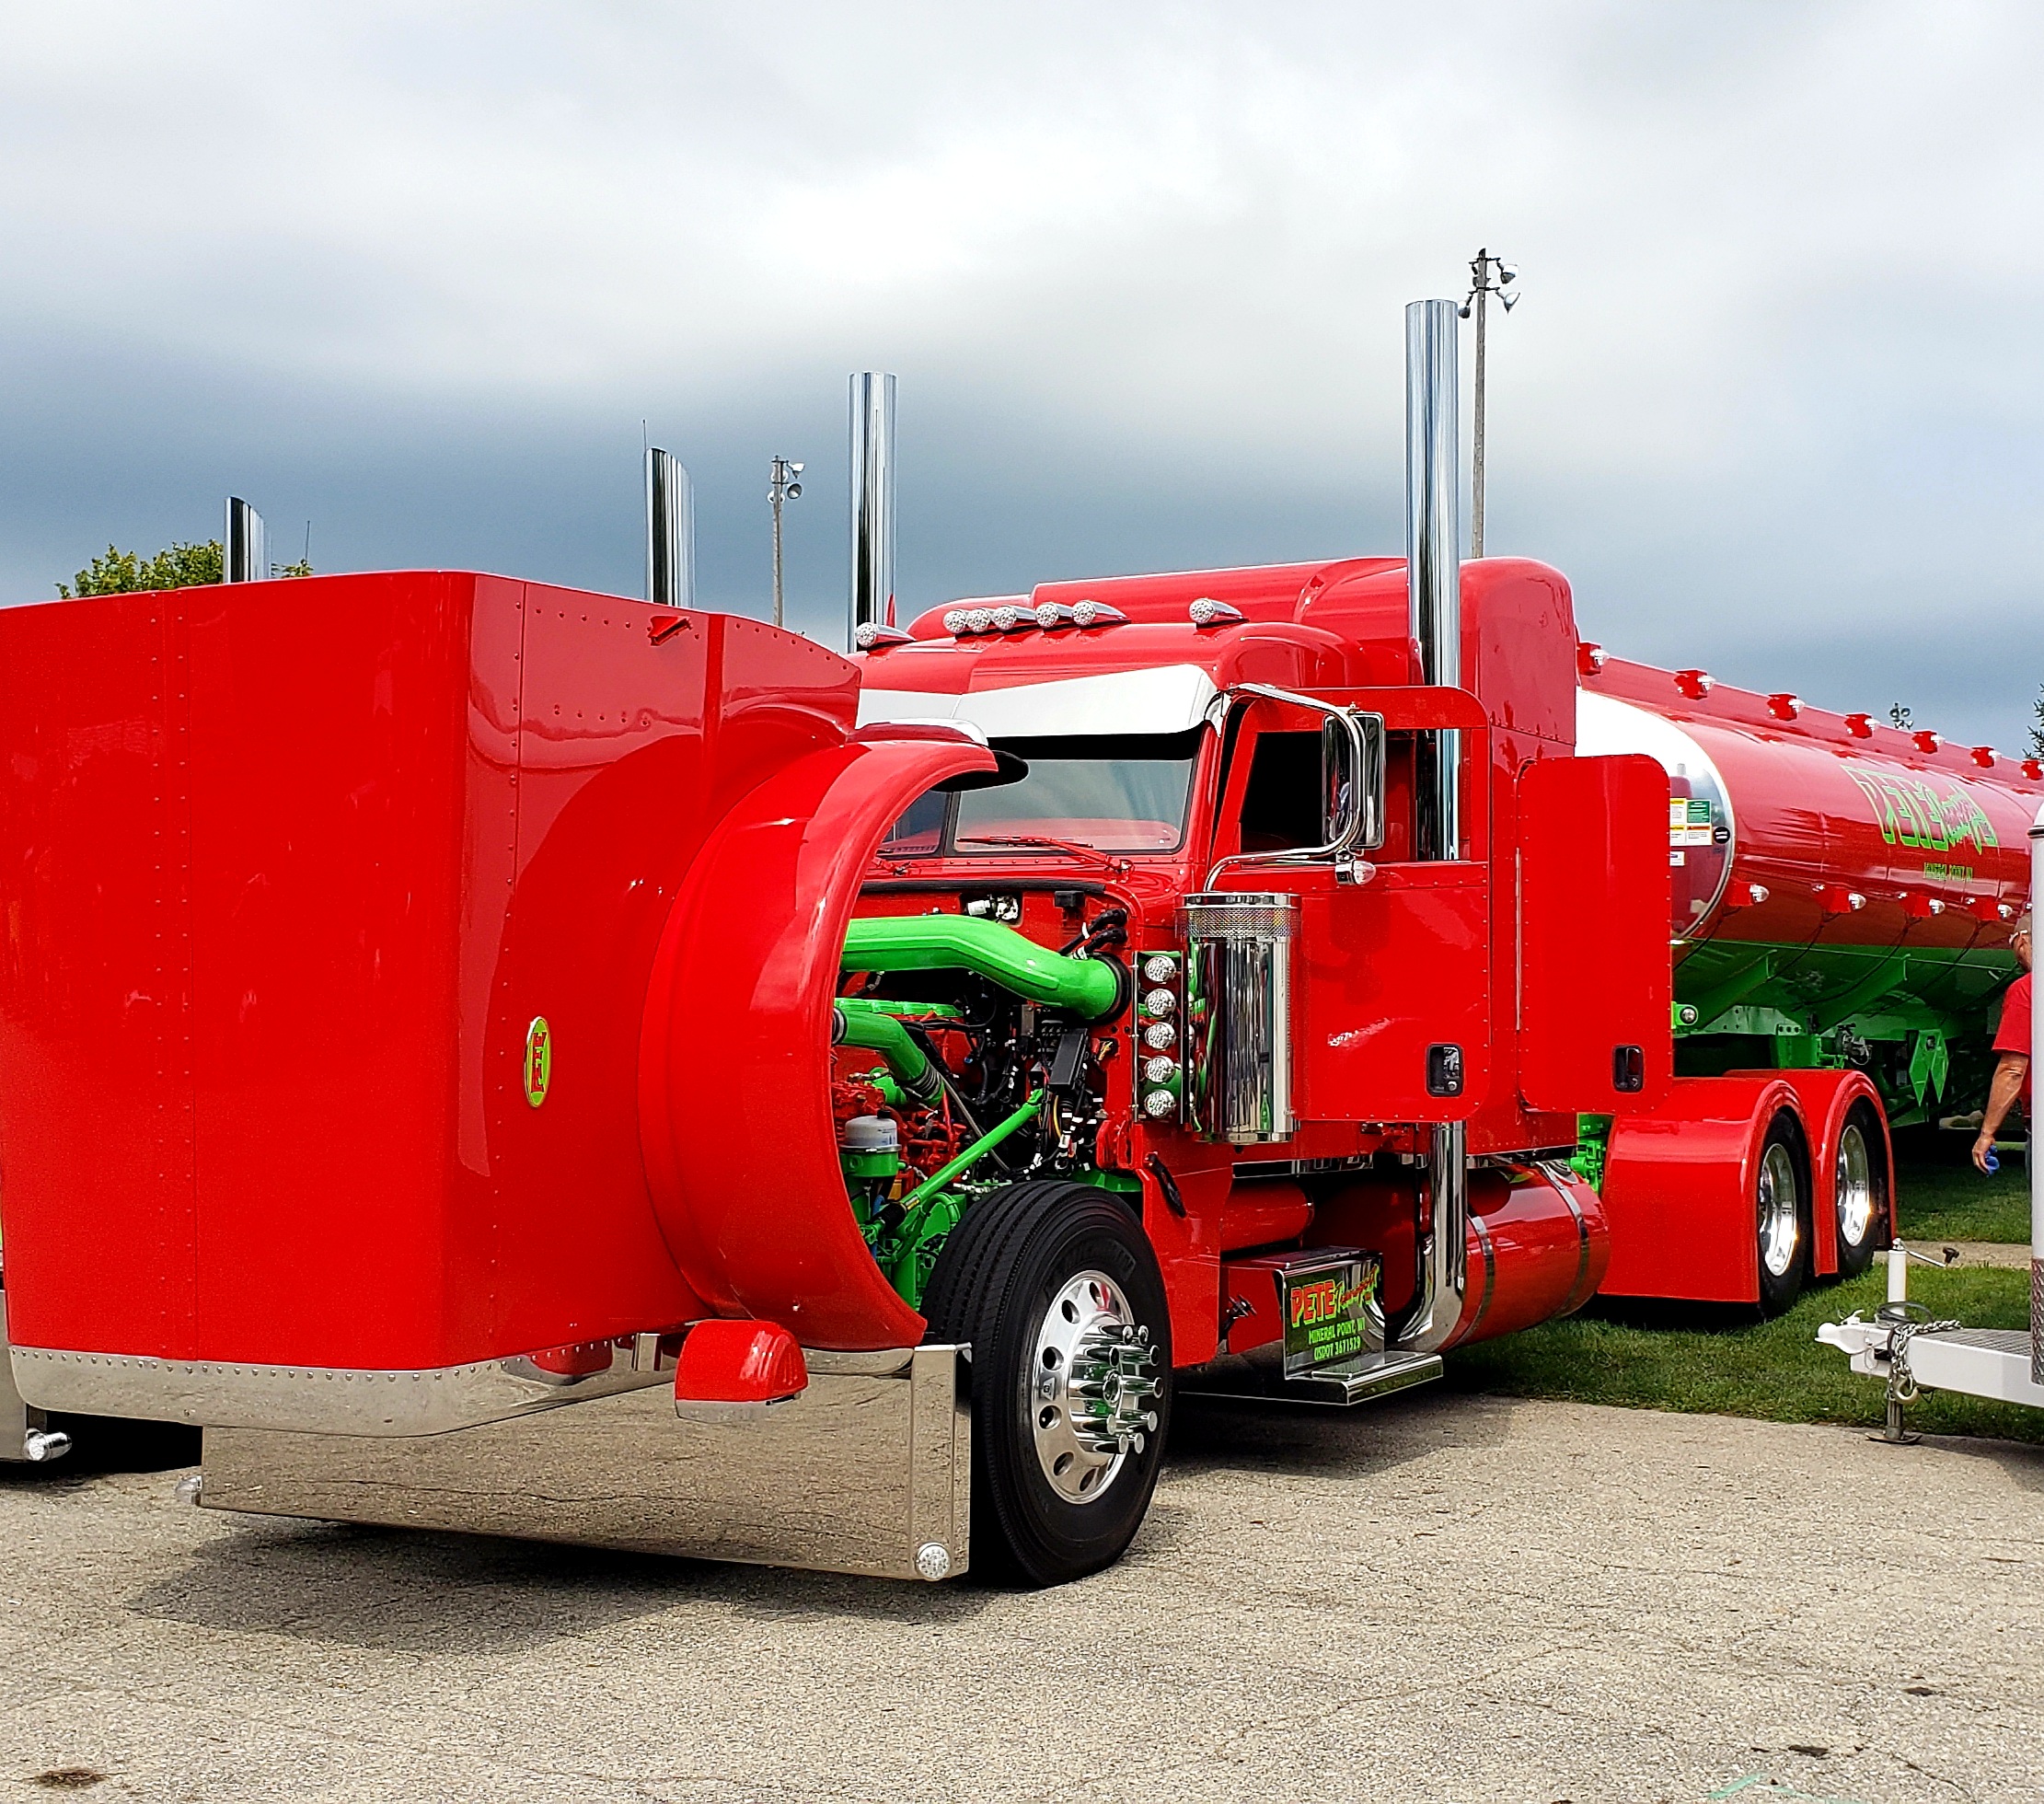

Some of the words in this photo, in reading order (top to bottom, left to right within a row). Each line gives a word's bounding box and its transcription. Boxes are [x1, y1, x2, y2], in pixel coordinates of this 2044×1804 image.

[1291, 1279, 1336, 1327] PETE
[1309, 1325, 1335, 1344] MINERAL
[1314, 1344, 1334, 1360] USDOT
